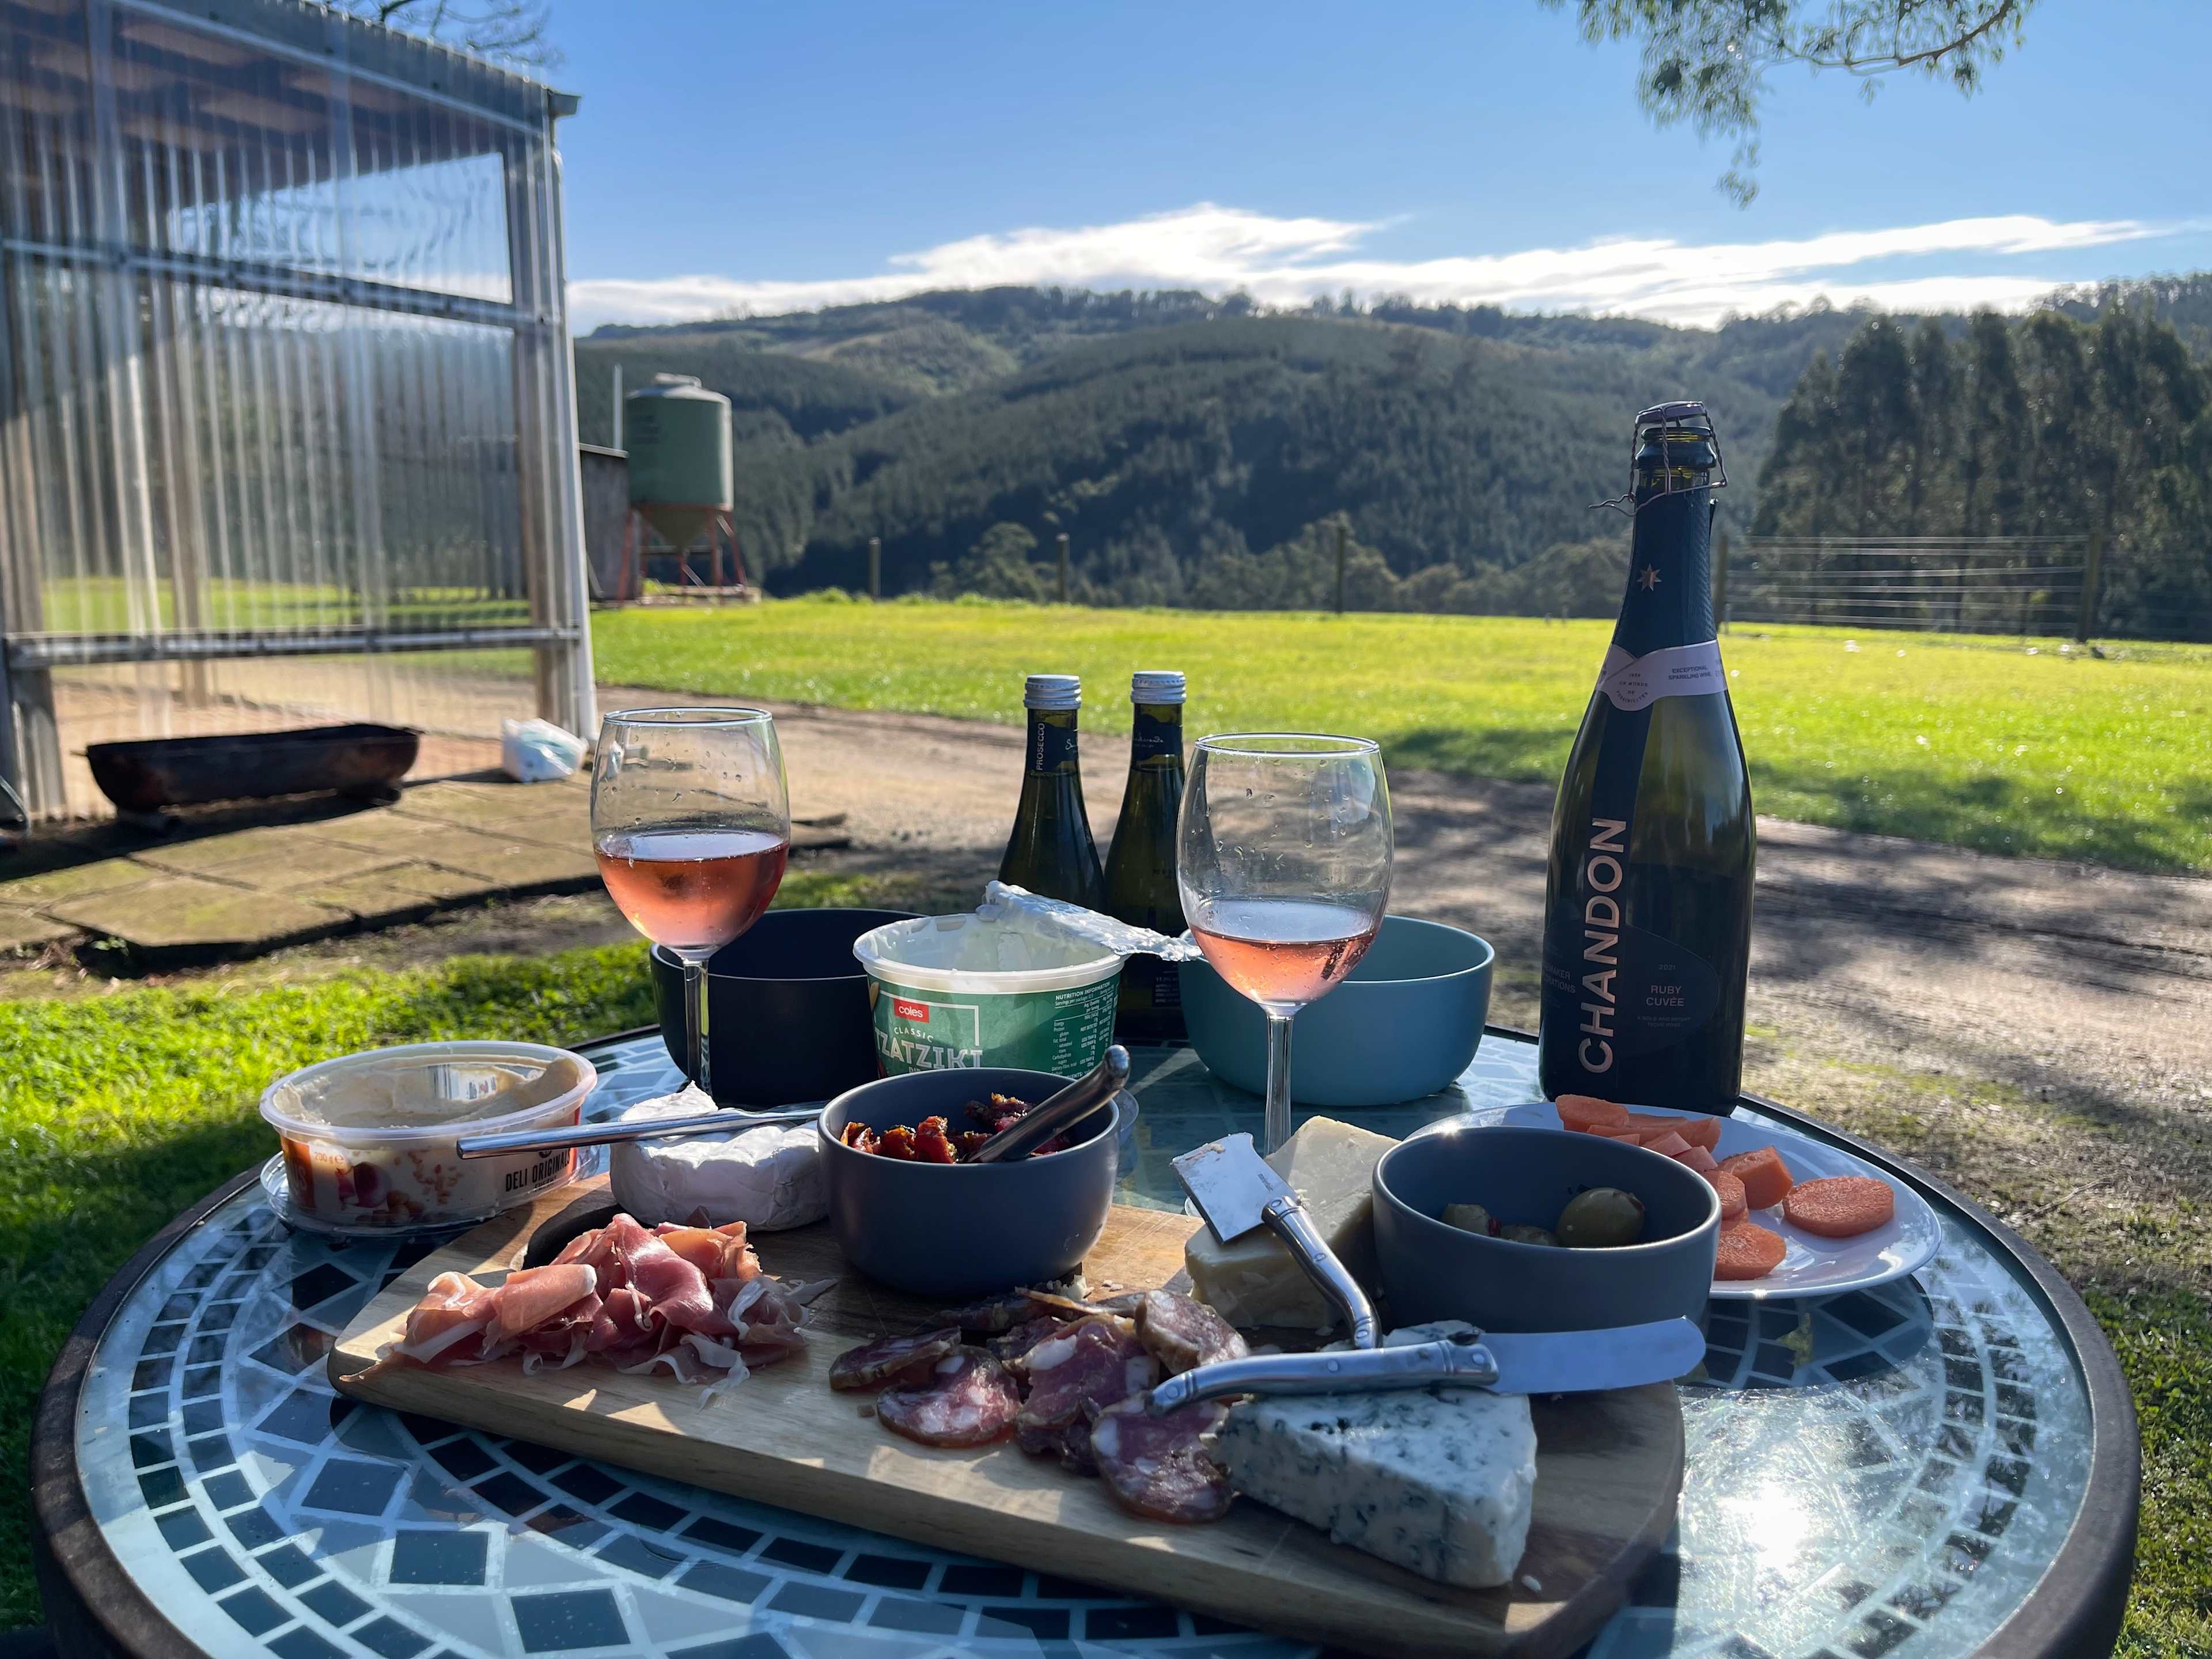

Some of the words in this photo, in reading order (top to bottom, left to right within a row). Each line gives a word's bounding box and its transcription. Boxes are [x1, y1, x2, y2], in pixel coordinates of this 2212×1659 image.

[1672, 665, 1708, 673] EXCEPTIONAL
[1036, 722, 1045, 771] PROSECCO
[1578, 817, 1627, 1074] CHANDON
[1055, 990, 1084, 1001] NUTRITION
[1084, 982, 1111, 995] INFORMATION
[1650, 984, 1682, 995] RUBY
[1646, 995, 1685, 1007] CUVÉE
[899, 1005, 923, 1018] coles
[894, 1027, 934, 1043] CLASSIC
[506, 1168, 528, 1192] DELI
[532, 1147, 570, 1183] ORIGINALS
